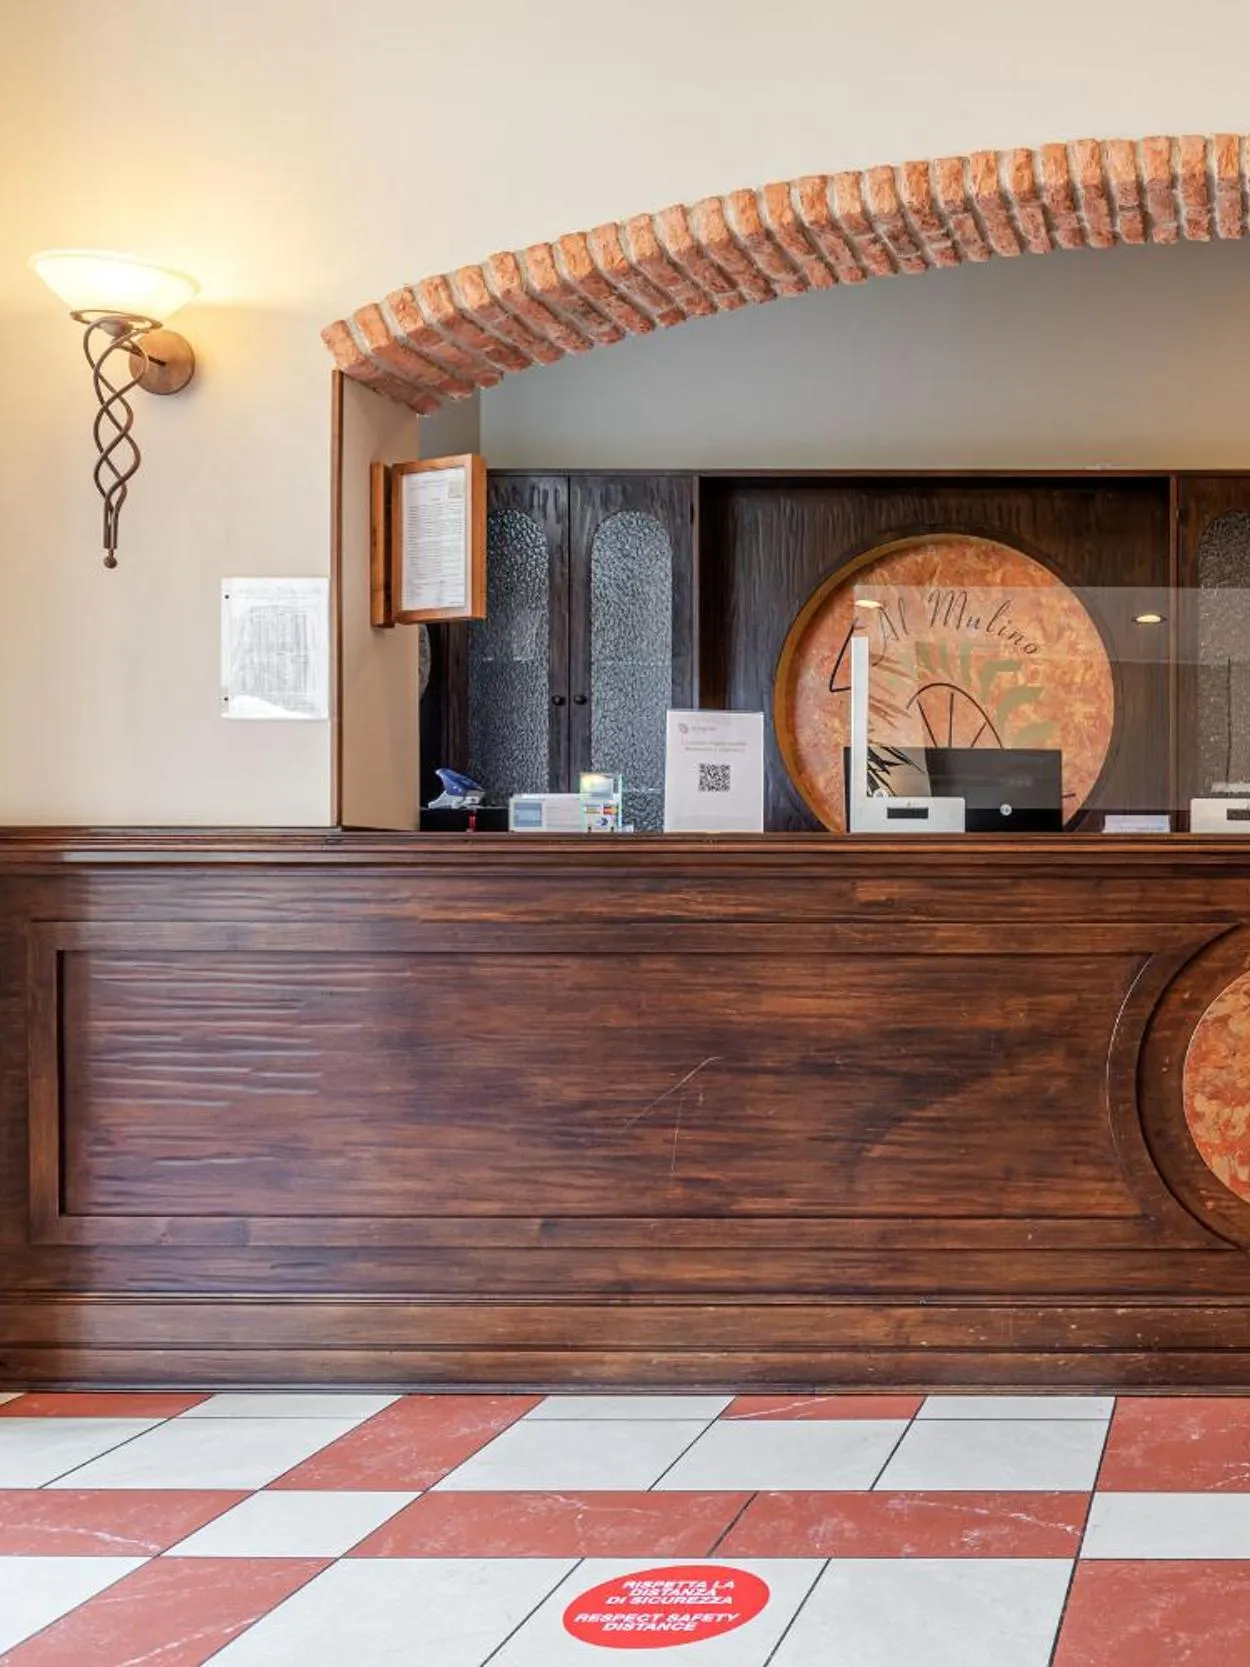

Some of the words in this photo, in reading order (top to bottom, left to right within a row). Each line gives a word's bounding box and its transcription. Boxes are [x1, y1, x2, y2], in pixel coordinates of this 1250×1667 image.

[927, 589, 1040, 655] Mulino
[623, 1580, 706, 1589] RISPETTA
[712, 1580, 736, 1589] LA
[629, 1588, 717, 1597] DISTANZA
[606, 1596, 627, 1605] DI
[629, 1595, 733, 1605] SICUREZZA
[575, 1613, 663, 1622] RESPECT
[668, 1613, 740, 1622] SAFETY
[602, 1622, 696, 1631] DISTANCE
